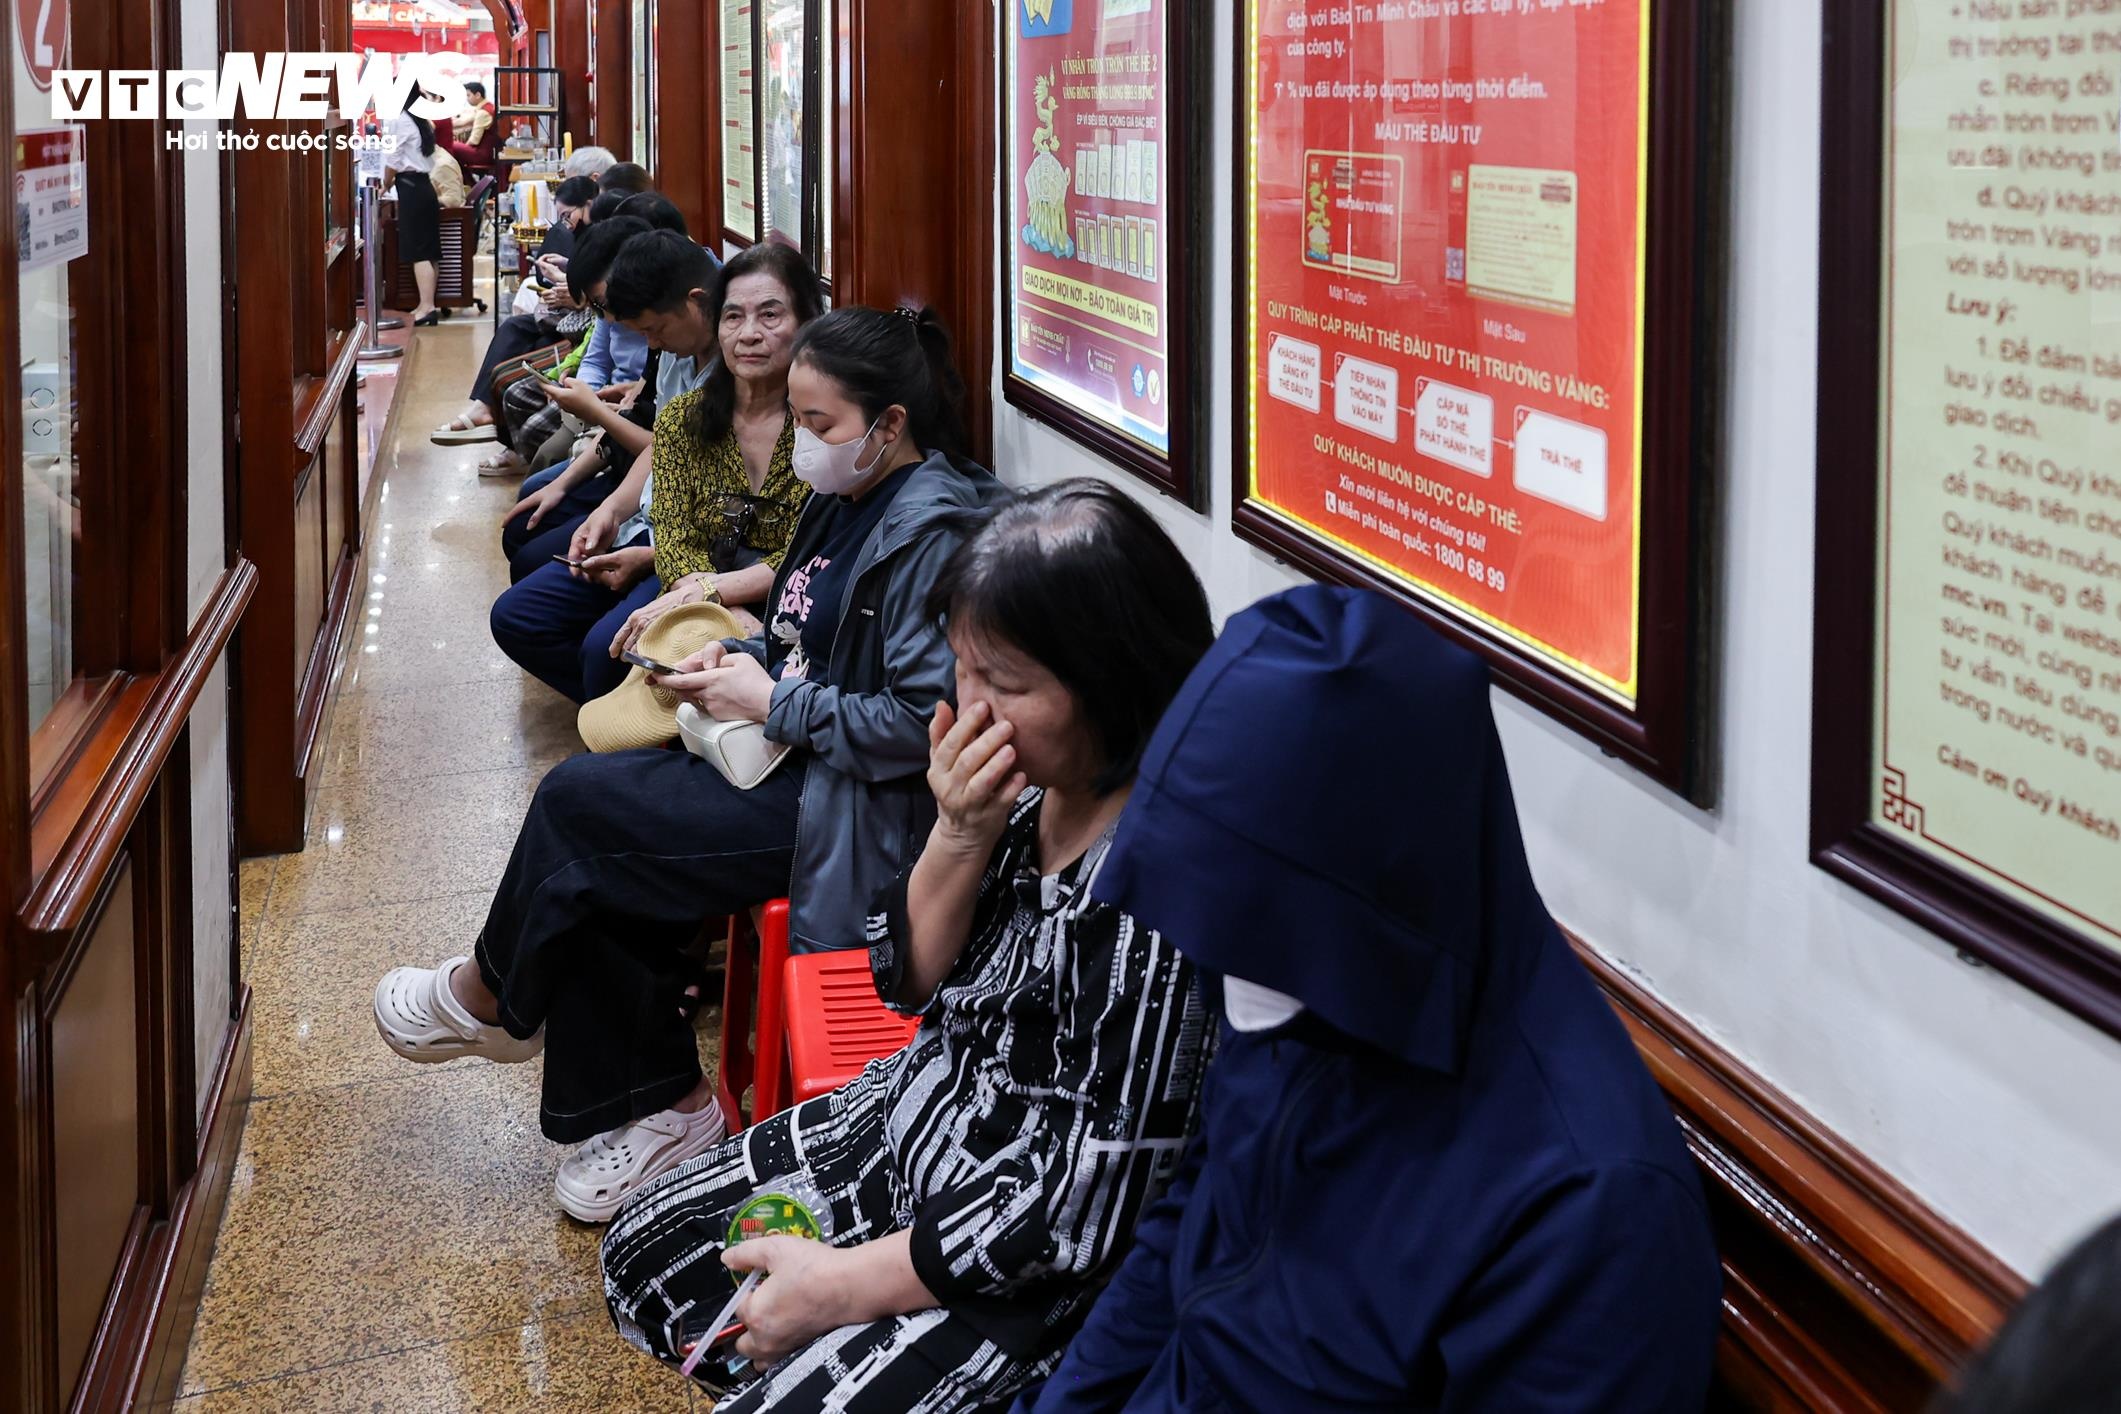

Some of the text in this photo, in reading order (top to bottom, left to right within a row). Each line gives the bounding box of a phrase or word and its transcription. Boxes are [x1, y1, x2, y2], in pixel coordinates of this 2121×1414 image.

[1287, 12, 1307, 31] dịch
[1311, 8, 1327, 26] với
[1331, 7, 1350, 25] Bảo
[1355, 5, 1373, 23] Tín
[1377, 3, 1404, 21] Minh
[1152, 54, 1158, 72] 2
[1307, 38, 1331, 58] công
[1315, 81, 1330, 98] đãi
[1332, 81, 1361, 103] được
[1363, 80, 1377, 101] áp
[1380, 81, 1409, 102] dụng
[1412, 80, 1439, 99] theo
[1442, 78, 1473, 103] từng
[1476, 77, 1504, 99] thời
[1507, 72, 1548, 99] điểm.
[1461, 125, 1482, 145] TƯ
[2040, 224, 2101, 257] Vàng
[2013, 259, 2080, 293] lượng
[1024, 272, 1155, 332] GIAO DỊCH MỌI NƠI BẢO TOÀN GIÁ TRỊ
[1946, 291, 1991, 318] Lưu
[1268, 300, 1288, 320] QUY
[1289, 305, 1318, 329] TRÌNH
[1344, 321, 1375, 344] PHÁT
[1376, 329, 1401, 352] THẺ
[1403, 334, 1432, 360] ĐẦU
[1434, 343, 1456, 366] TƯ
[1458, 349, 1480, 378] THỊ
[1483, 356, 1552, 393] TRƯỜNG
[1554, 373, 1611, 410] VÀNG:
[2001, 336, 2030, 364] Để
[1350, 386, 1387, 409] THÔNG TIN
[1944, 403, 1988, 427] giao
[1314, 433, 1335, 456] QUÝ
[1337, 442, 1376, 473] KHÁCH
[1415, 473, 1454, 506] ĐƯỢC
[1488, 503, 1523, 535] THẺ:
[2037, 459, 2083, 495] Quý
[1339, 473, 1486, 552] Xin mời liên hệ với chúng tôi!
[1338, 499, 1505, 592] Miễn phí toàn quốc: 1800 68 99
[1943, 510, 1983, 544] Quý
[1989, 522, 2054, 561] khách
[1942, 545, 2002, 580] khách
[2011, 567, 2067, 607] hàng
[1941, 616, 1979, 645] sức
[2037, 650, 2093, 690] cùng
[1940, 681, 1991, 723] trong
[1997, 706, 2055, 743] nước
[1938, 744, 1978, 777] Cảm
[2013, 778, 2053, 814] Quý
